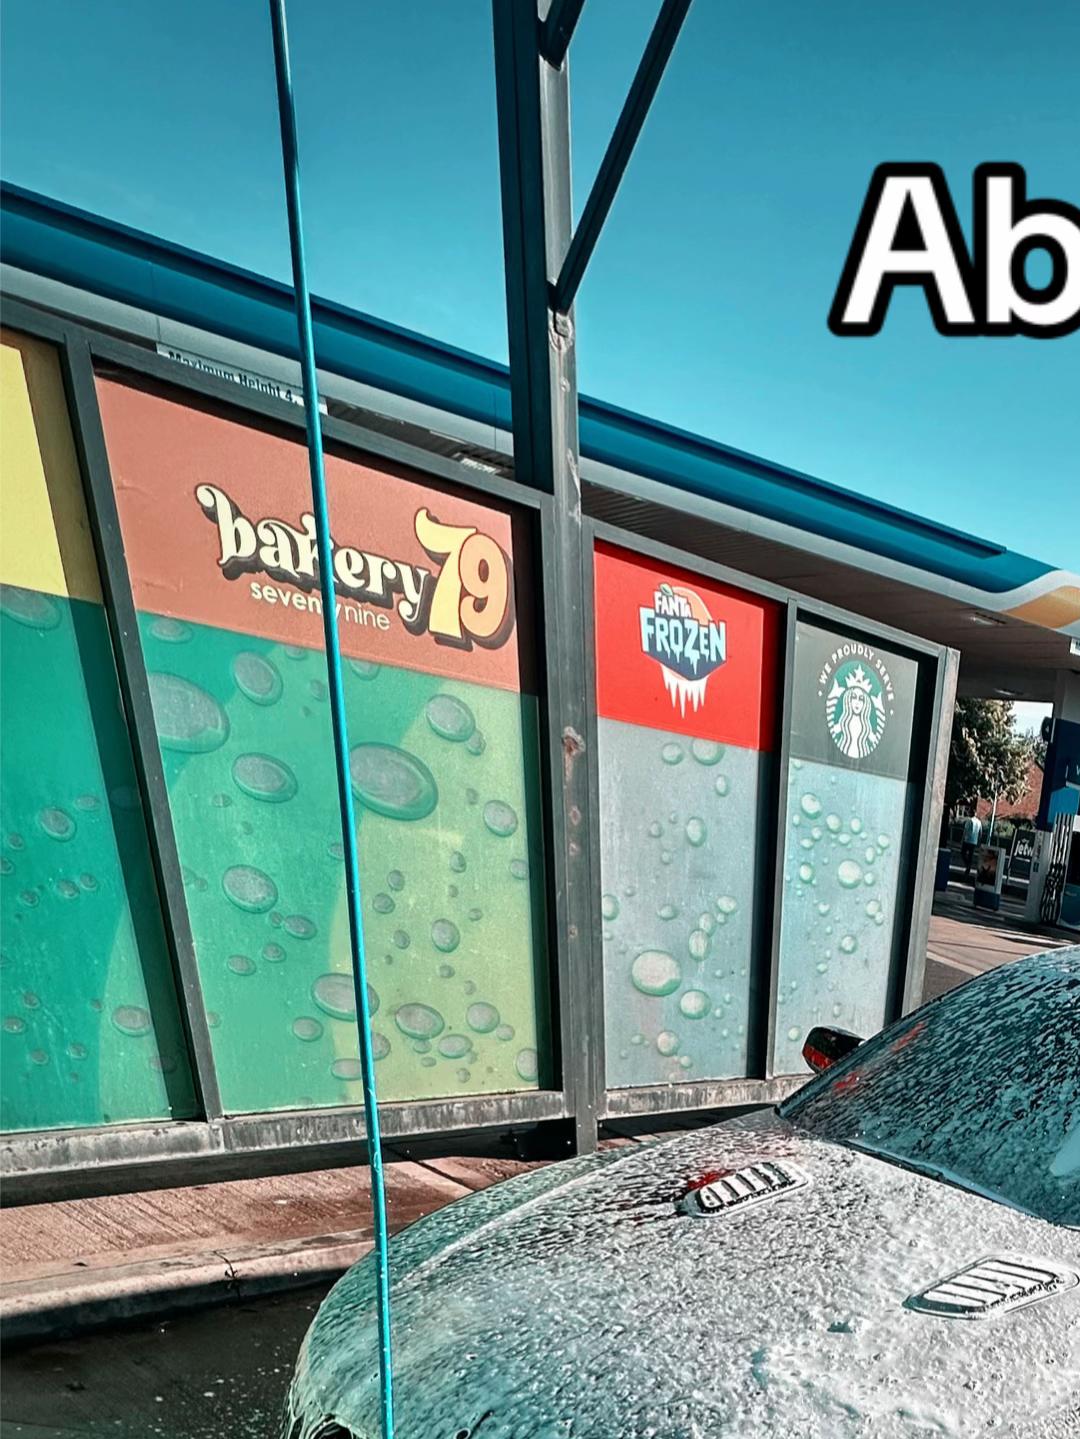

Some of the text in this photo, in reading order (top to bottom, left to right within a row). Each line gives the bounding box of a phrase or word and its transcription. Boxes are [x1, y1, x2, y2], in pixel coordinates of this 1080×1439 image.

[413, 507, 509, 640] 79
[250, 581, 391, 631] seven nine
[653, 590, 693, 618] FANTA
[639, 606, 727, 674] FROZEN
[819, 643, 895, 701] WE PROUDLY SERVE
[1014, 840, 1034, 857] jetw
